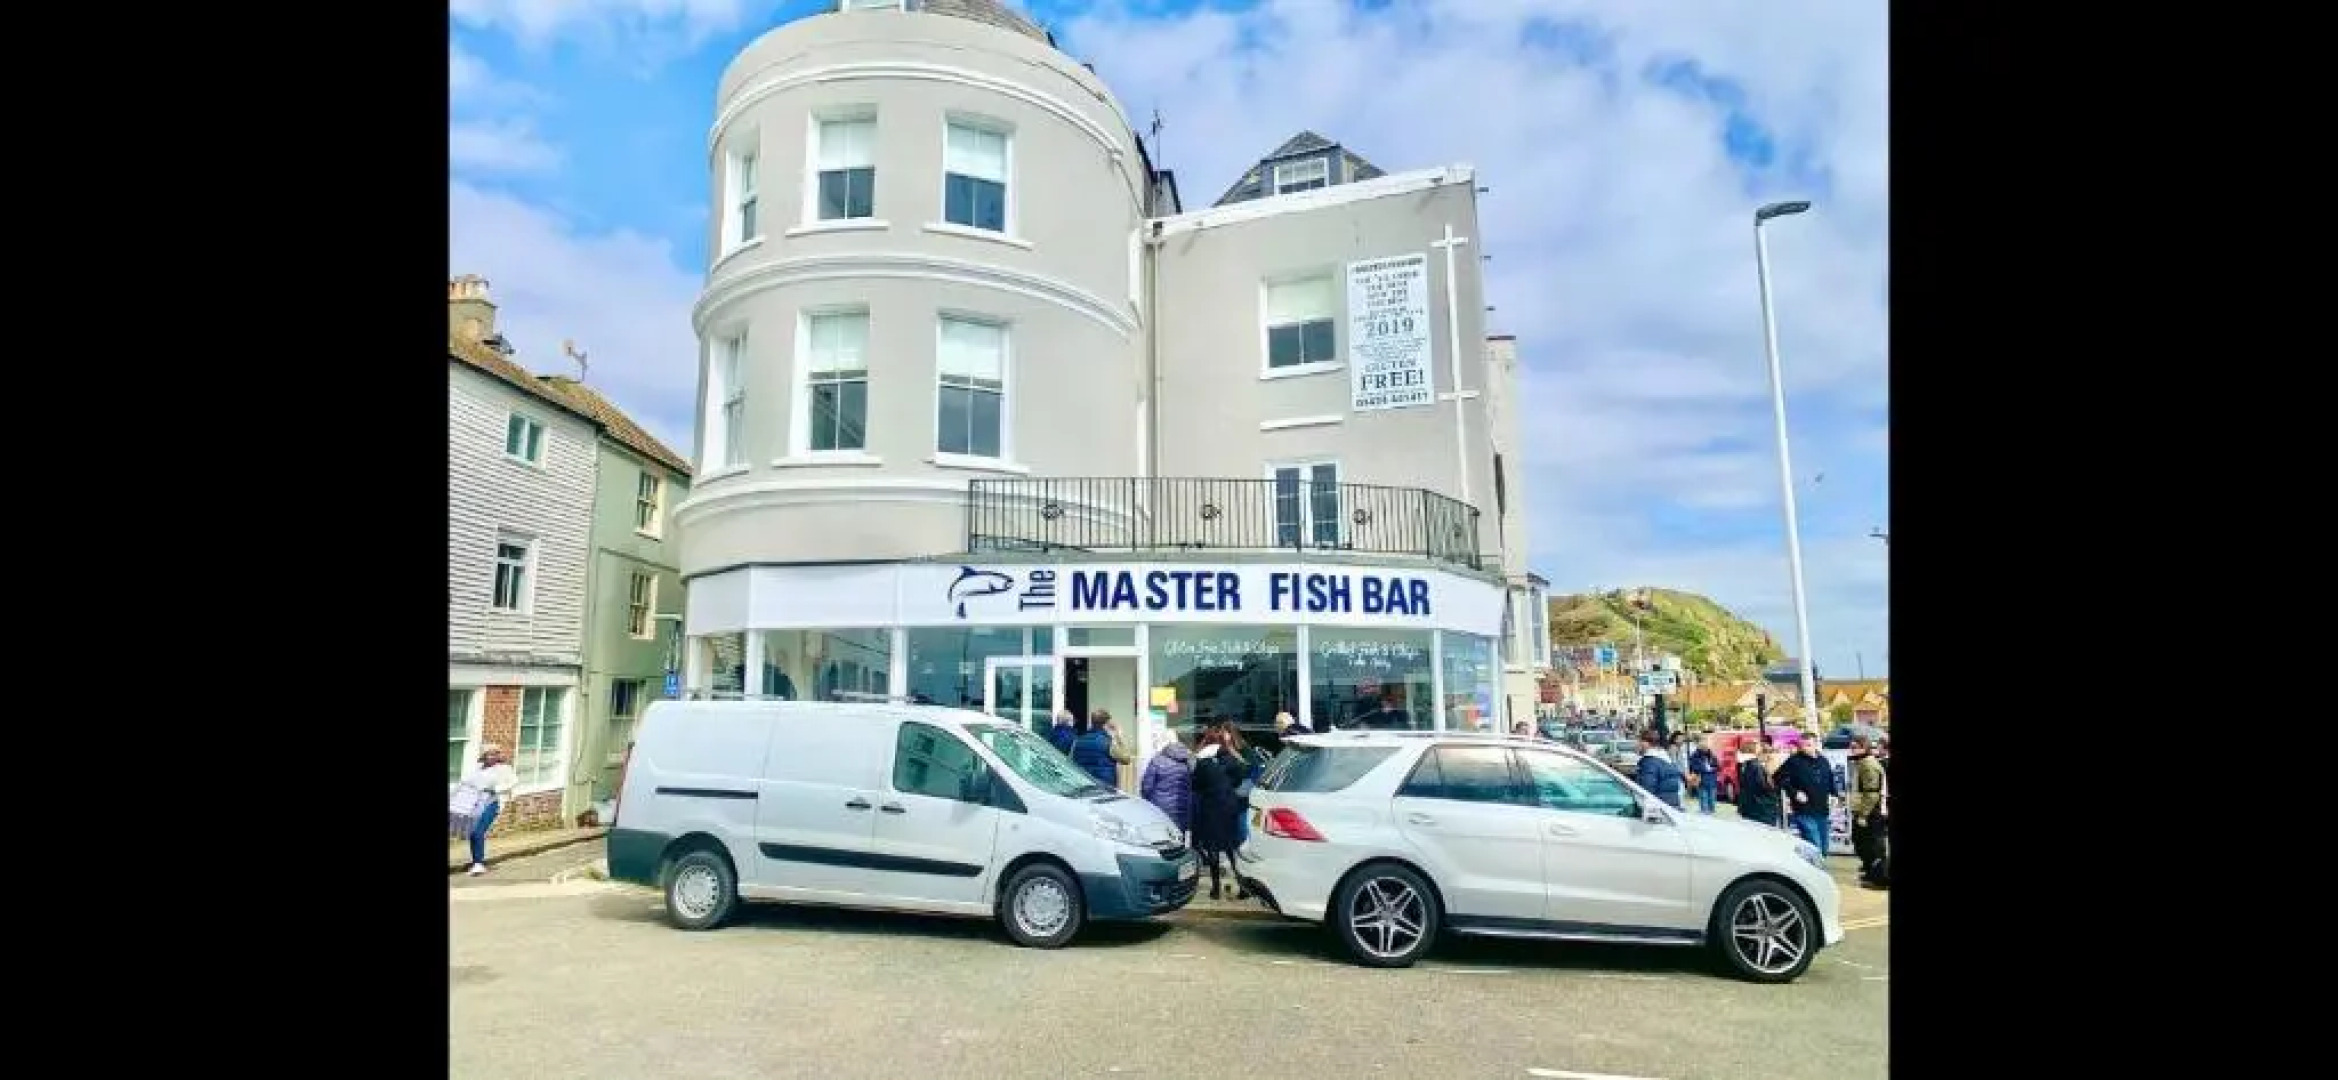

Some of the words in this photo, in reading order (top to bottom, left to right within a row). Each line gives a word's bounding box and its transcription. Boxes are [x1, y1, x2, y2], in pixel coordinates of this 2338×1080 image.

[1367, 317, 1413, 337] 2019
[1361, 369, 1423, 390] FREE!
[1018, 570, 1055, 611] The
[1072, 570, 1241, 611] MASTER
[1270, 572, 1351, 613] FISH
[1362, 576, 1430, 615] BAR
